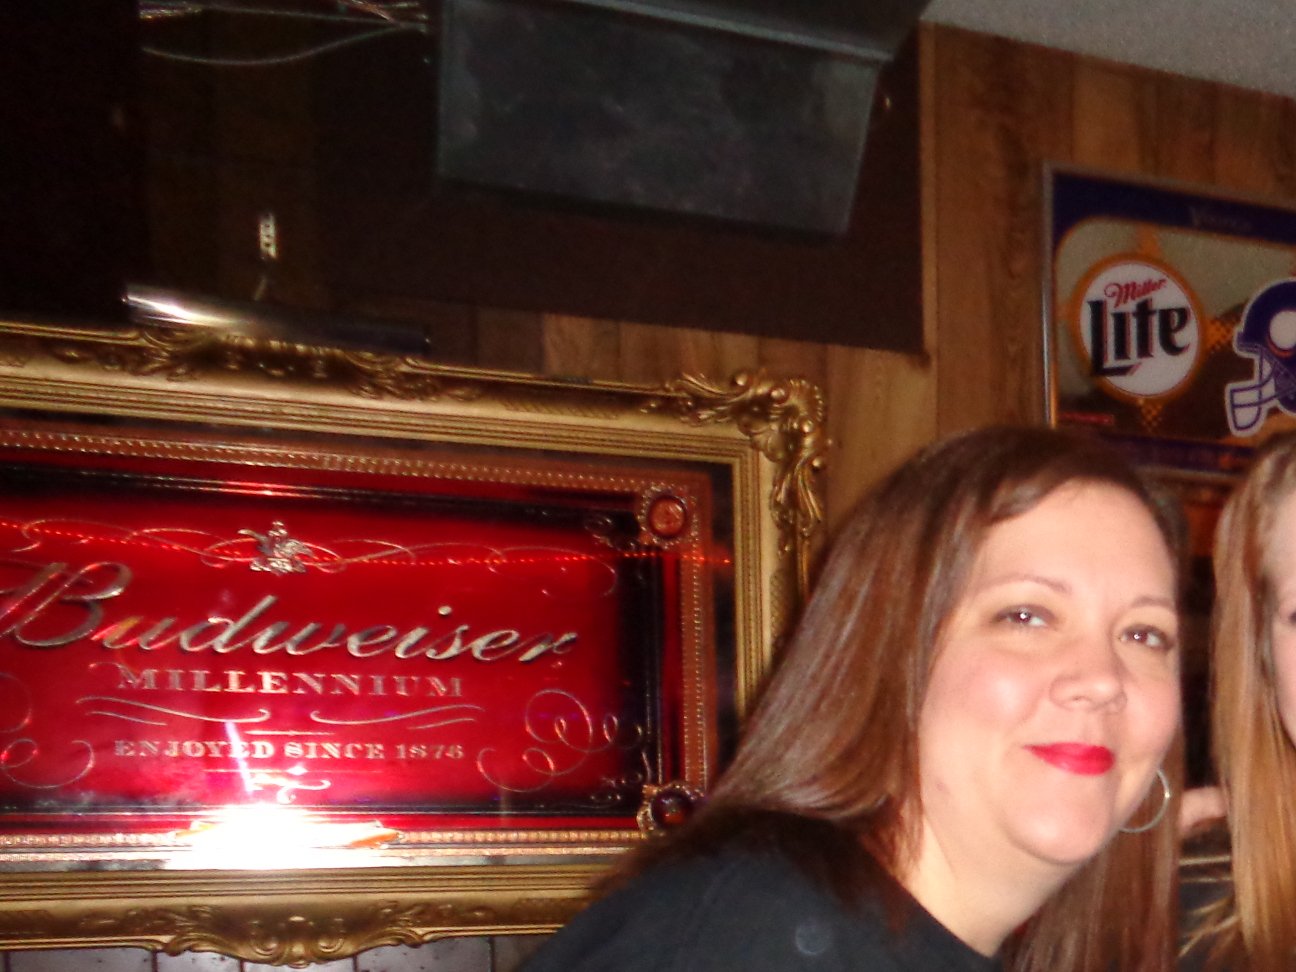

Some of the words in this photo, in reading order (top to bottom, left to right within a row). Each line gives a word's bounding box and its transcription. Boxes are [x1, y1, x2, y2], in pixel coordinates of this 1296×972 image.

[1104, 278, 1167, 308] Miller
[1087, 298, 1191, 376] Lite
[0, 561, 578, 662] Budweiser
[112, 662, 463, 697] MILLENNIUM
[114, 740, 275, 759] ENJOYED
[284, 741, 385, 759] SINCE
[396, 743, 464, 760] 1876
